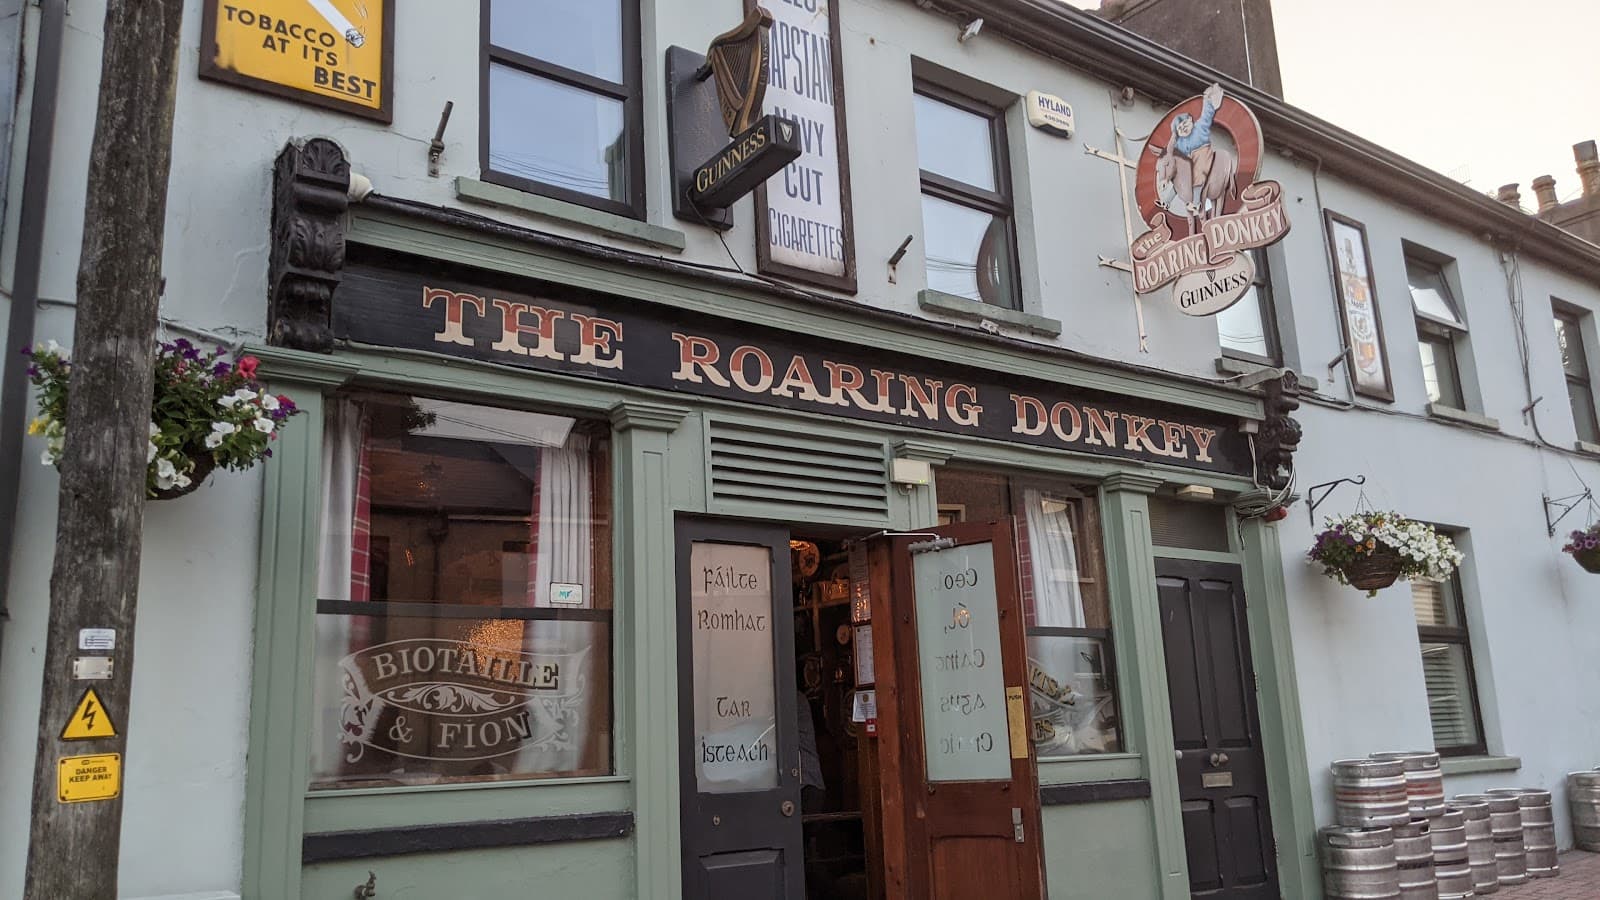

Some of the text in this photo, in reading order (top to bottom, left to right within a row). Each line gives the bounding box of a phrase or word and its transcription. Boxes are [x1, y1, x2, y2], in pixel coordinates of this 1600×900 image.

[223, 5, 336, 48] TOBACCO
[262, 34, 338, 67] AT ITS
[768, 19, 833, 106] APSTAN
[314, 66, 376, 98] BEST
[1038, 95, 1071, 117] HYLAND
[775, 105, 824, 157] VY
[696, 127, 765, 192] GUINNESS
[784, 162, 823, 206] CUT
[768, 207, 843, 262] CIGARETTES
[1136, 232, 1162, 255] The
[1137, 206, 1283, 289] ROARING DONKEY
[1180, 270, 1248, 309] GUINNESS
[422, 286, 1216, 464] THE ROARING DONKEY
[388, 715, 413, 744] &
[69, 773, 112, 783] KEEP AWAY
[75, 766, 107, 775] DANGER
